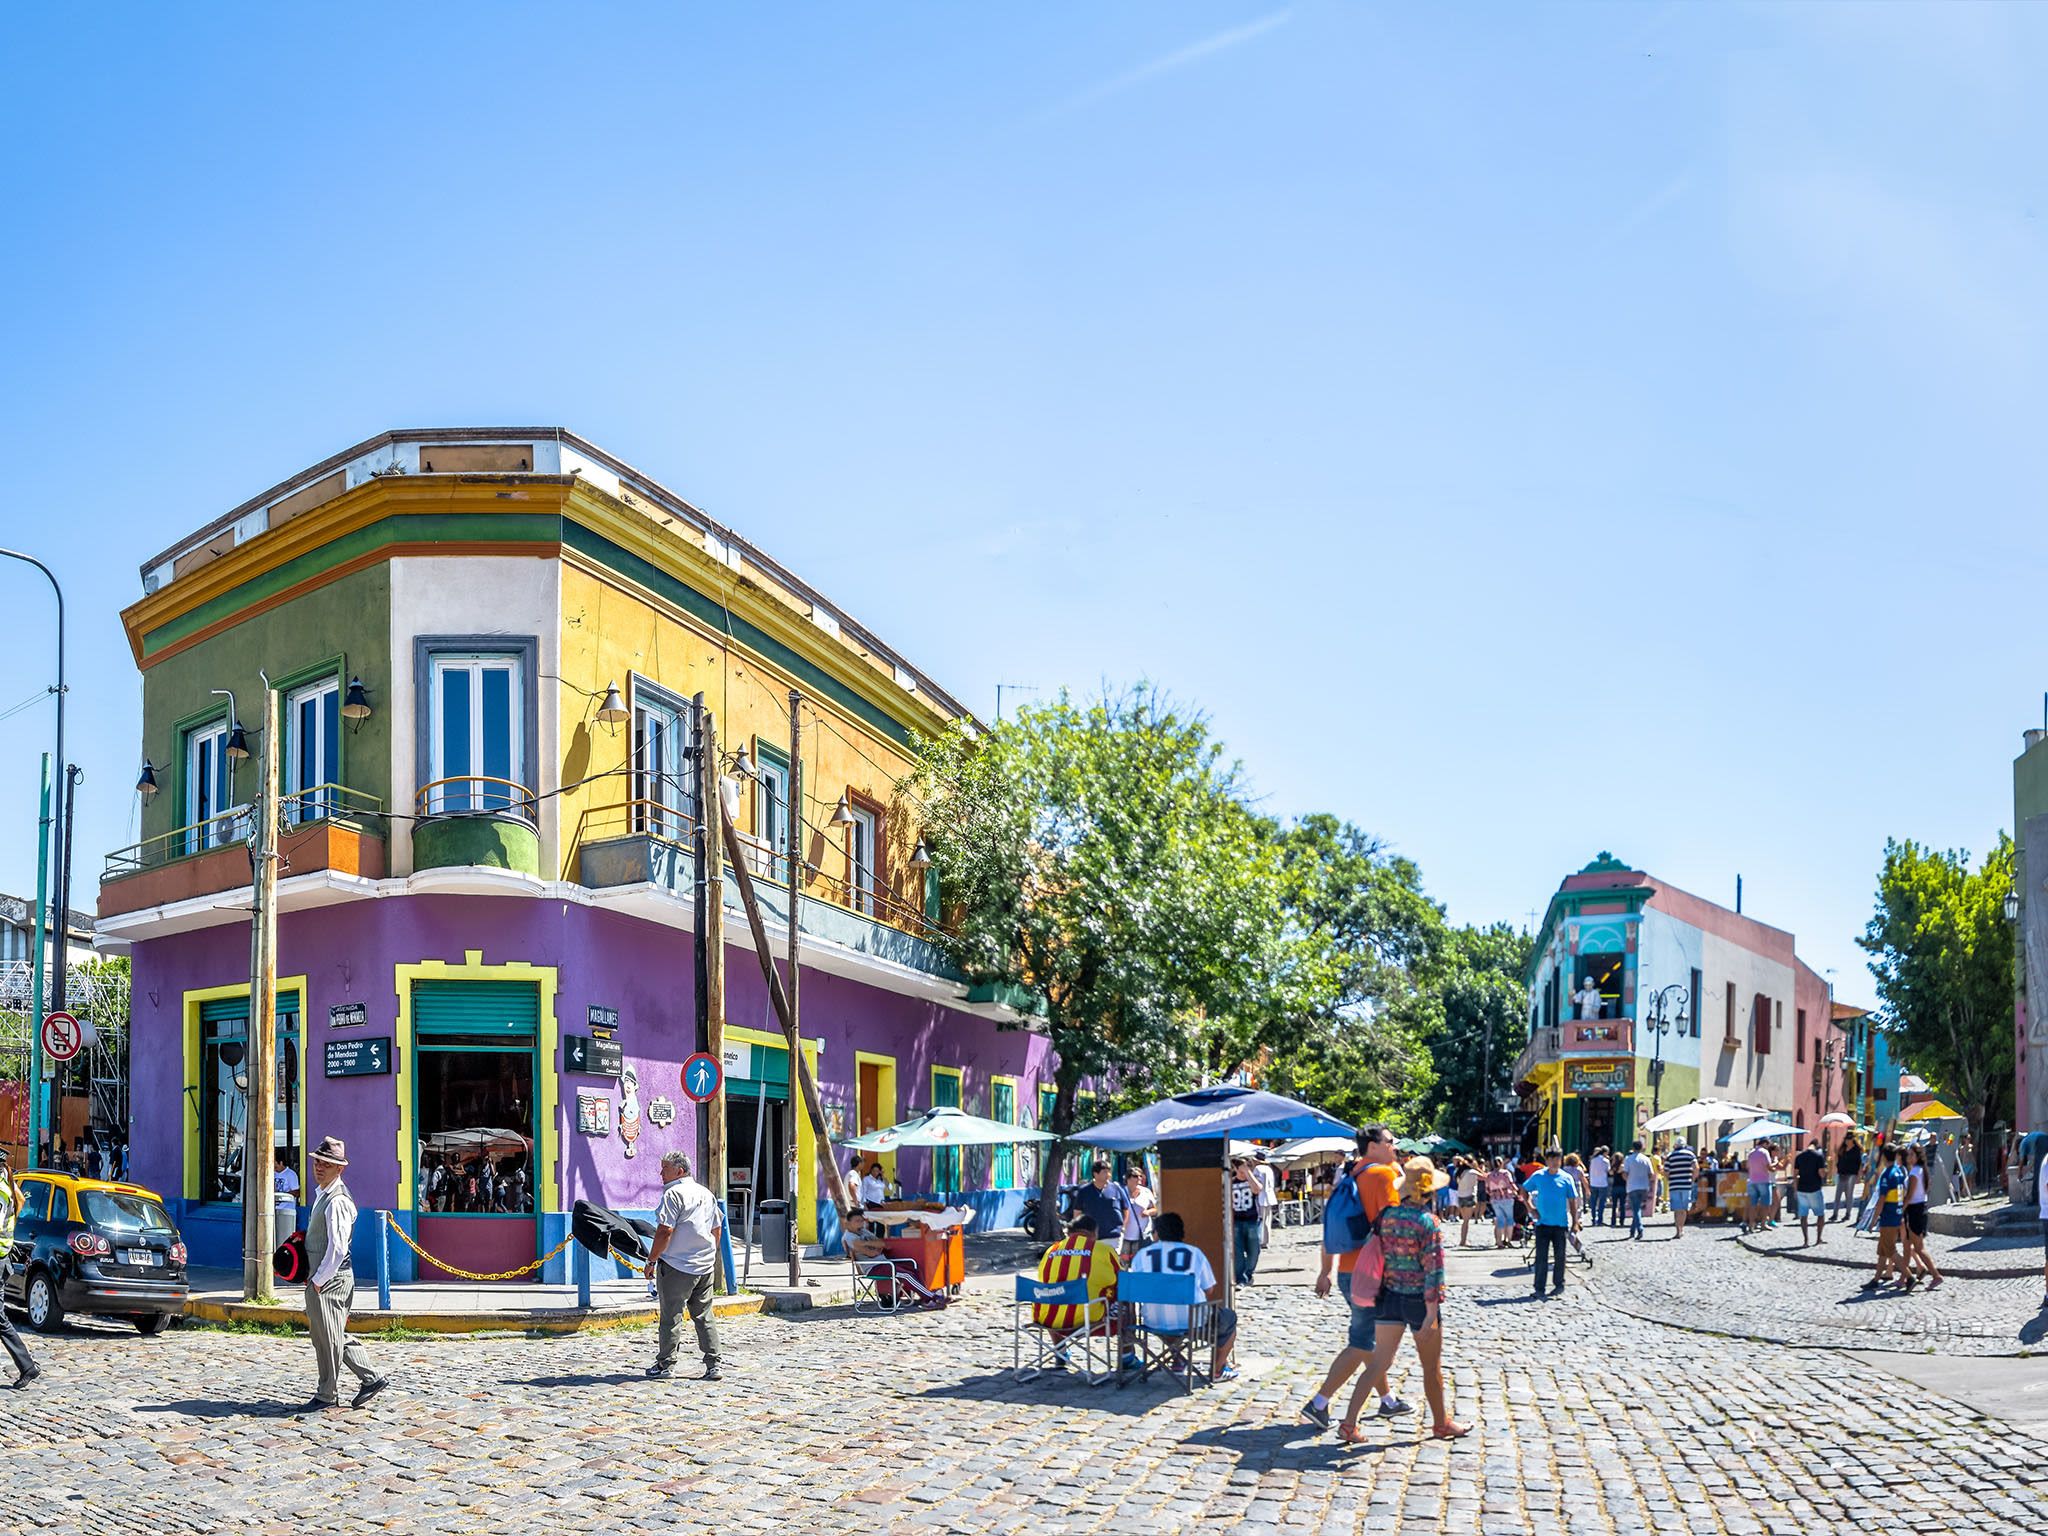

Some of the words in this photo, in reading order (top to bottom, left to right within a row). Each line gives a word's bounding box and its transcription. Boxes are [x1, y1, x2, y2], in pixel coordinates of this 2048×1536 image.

[589, 1009, 618, 1026] MAGALLANES
[348, 1041, 363, 1049] Pedro
[596, 1040, 620, 1050] Magallanes
[1574, 1070, 1624, 1083] CAMINITO
[1156, 1103, 1246, 1135] Quilmes
[1146, 1247, 1193, 1272] 10
[1033, 1285, 1066, 1299] Quilmes
